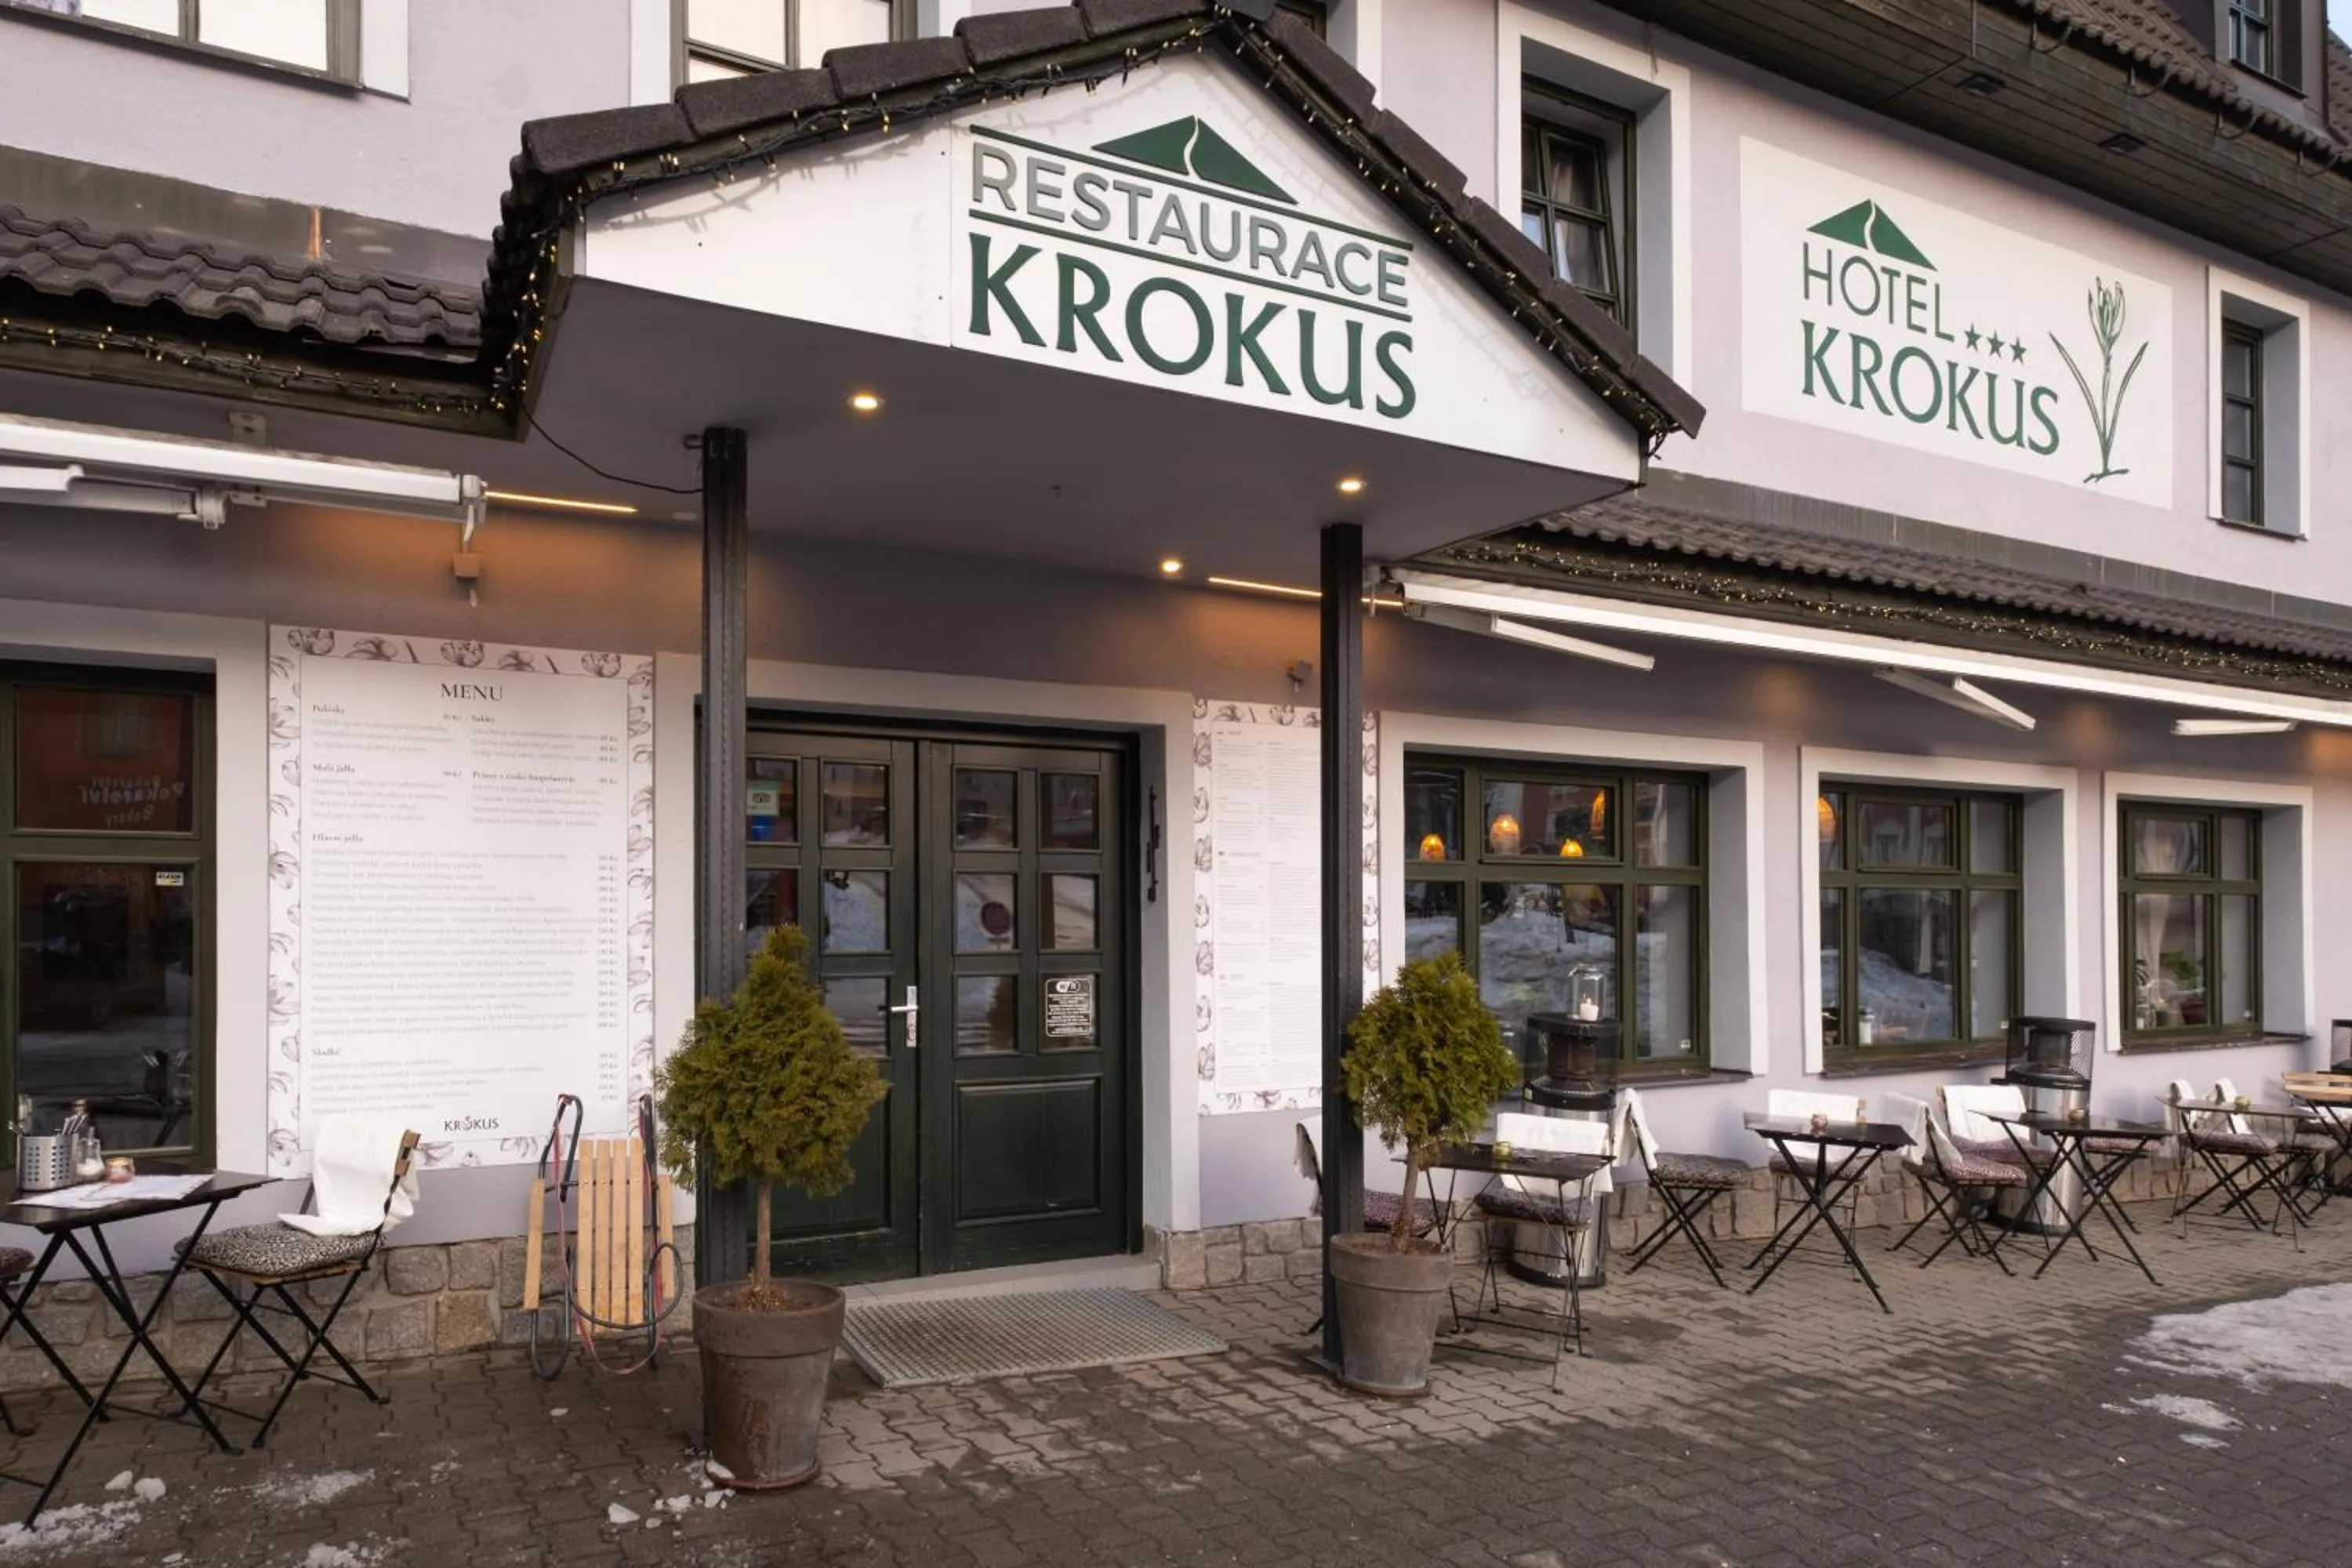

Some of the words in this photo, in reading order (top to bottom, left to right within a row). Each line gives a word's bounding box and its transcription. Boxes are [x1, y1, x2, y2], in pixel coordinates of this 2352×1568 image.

[972, 142, 1409, 307] RESTAURACE
[969, 232, 1416, 419] KROKUS
[1804, 241, 1955, 343] HOTEL
[1801, 319, 2060, 456] KROKUS
[440, 683, 503, 701] MENU
[445, 1116, 500, 1132] KROKUS
